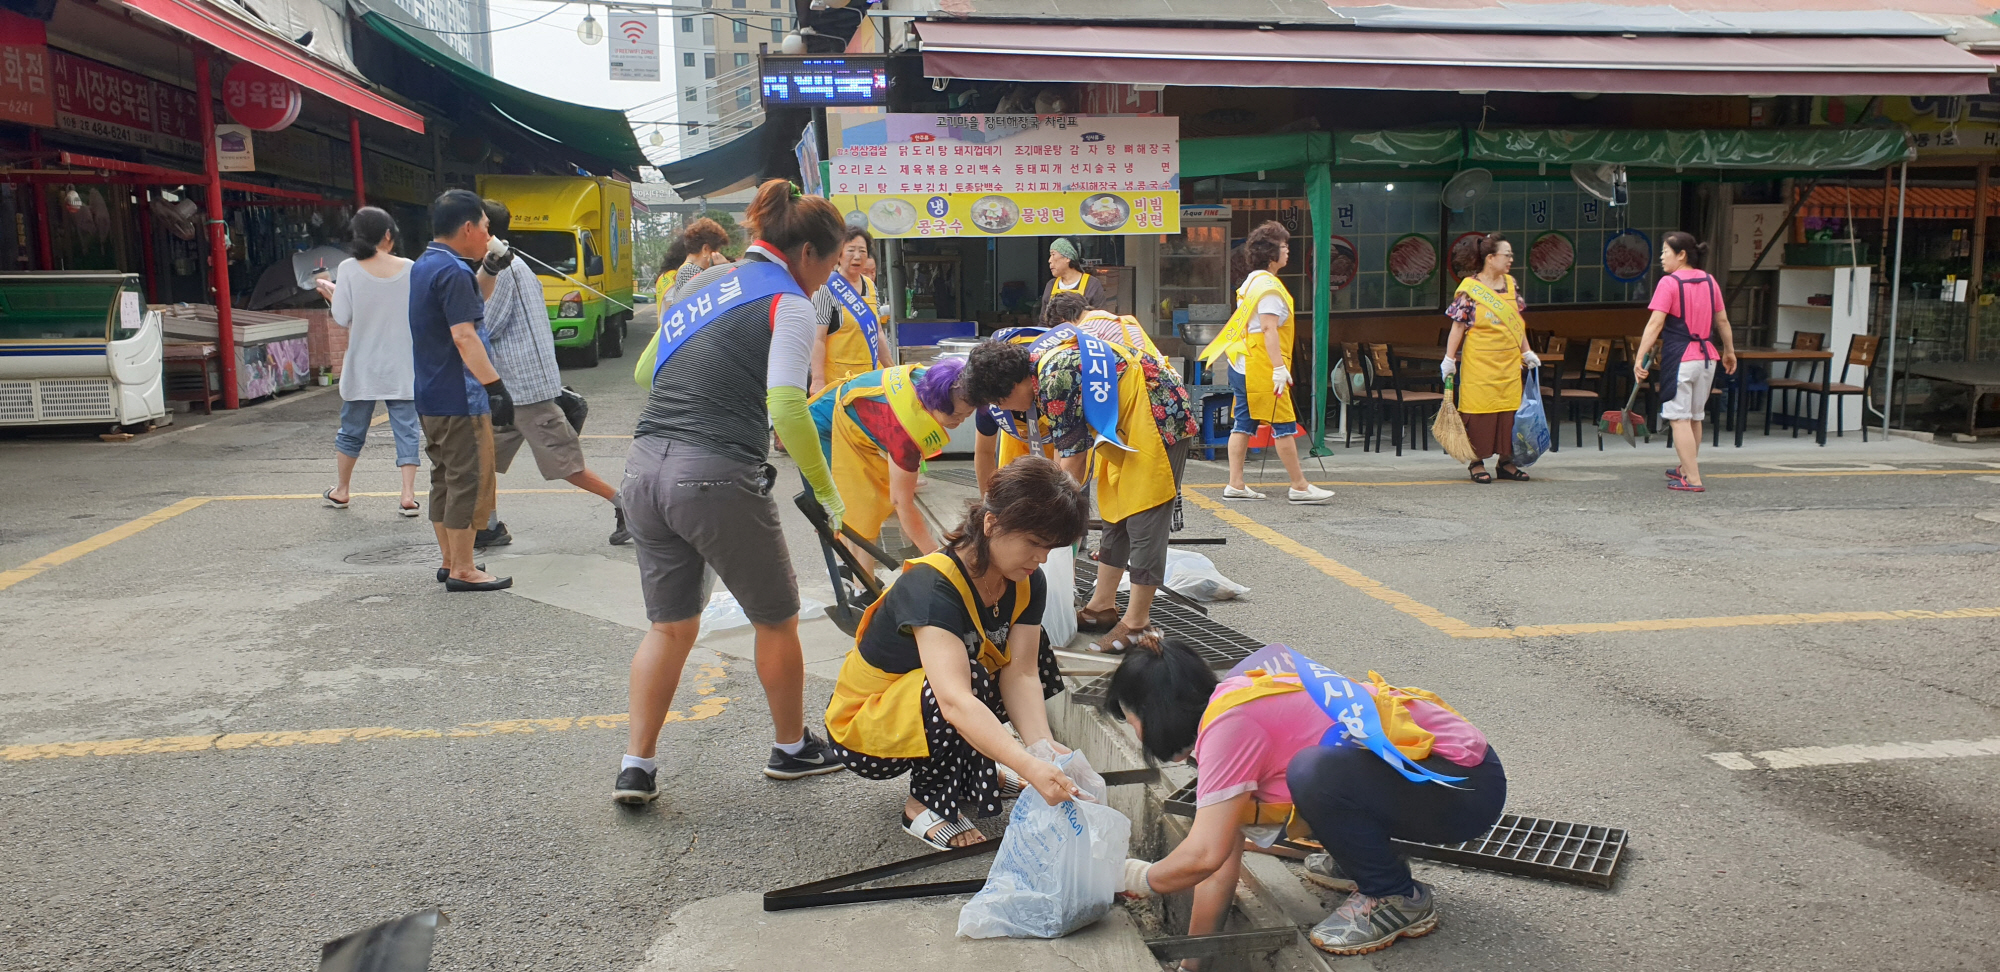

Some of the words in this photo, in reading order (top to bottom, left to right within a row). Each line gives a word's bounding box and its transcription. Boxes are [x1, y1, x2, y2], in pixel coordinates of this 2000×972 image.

[0, 46, 46, 95] 화점
[75, 66, 150, 122] 시장정육점
[227, 79, 288, 109] 정육점
[935, 115, 980, 131] 고기마을
[984, 115, 1040, 131] 장터해장국
[1044, 115, 1078, 130] 차림표
[954, 145, 1003, 157] 돼지껍데기
[1014, 145, 1063, 157] 조기매운탕
[1021, 207, 1065, 224] 물냉면
[1134, 196, 1163, 213] 비빔
[916, 219, 964, 235] 콩국수
[1134, 213, 1163, 228] 냉면
[663, 275, 743, 343] 깨끗한
[831, 278, 868, 317] 친절한
[1084, 331, 1112, 403] 민시장
